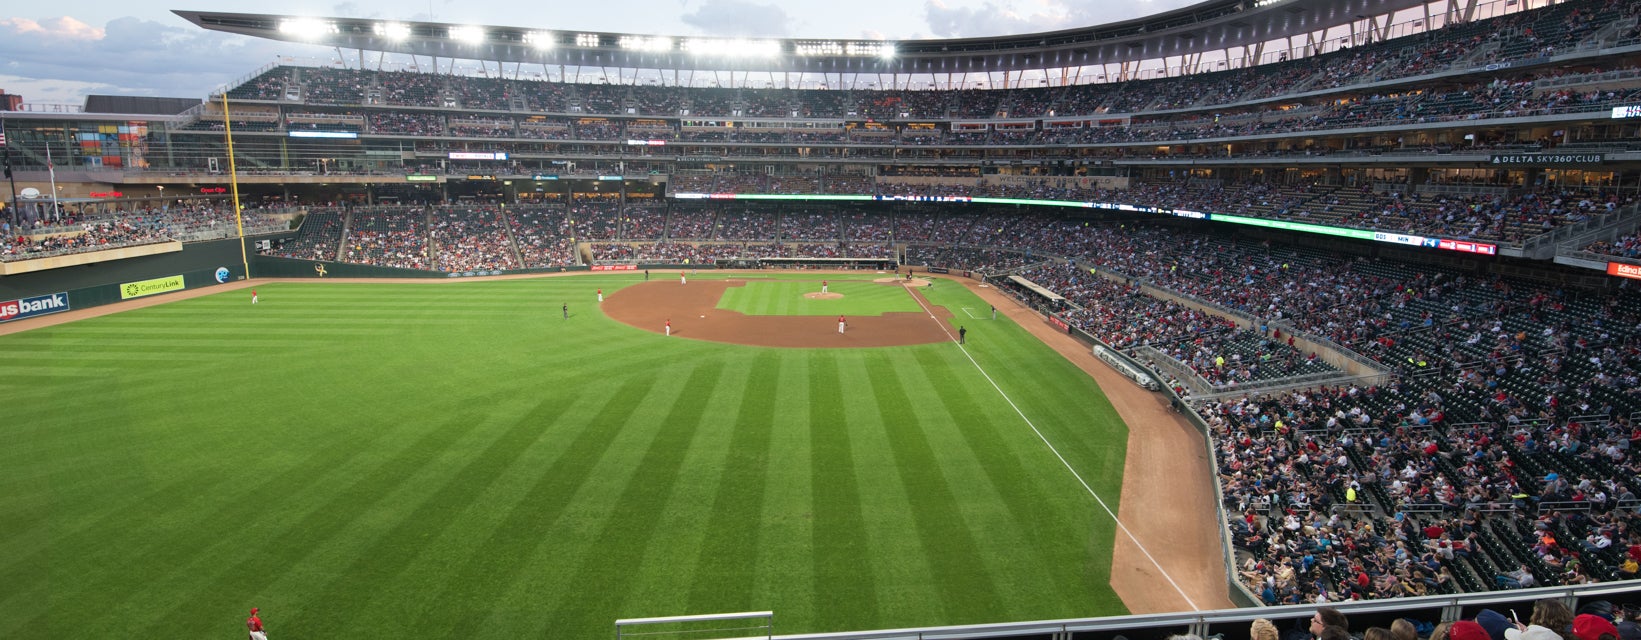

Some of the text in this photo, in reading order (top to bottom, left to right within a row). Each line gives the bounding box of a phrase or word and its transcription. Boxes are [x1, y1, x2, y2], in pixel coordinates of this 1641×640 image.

[1502, 155, 1534, 163] DELTA
[1618, 264, 1638, 275] Edina
[141, 280, 180, 291] CenturyLink
